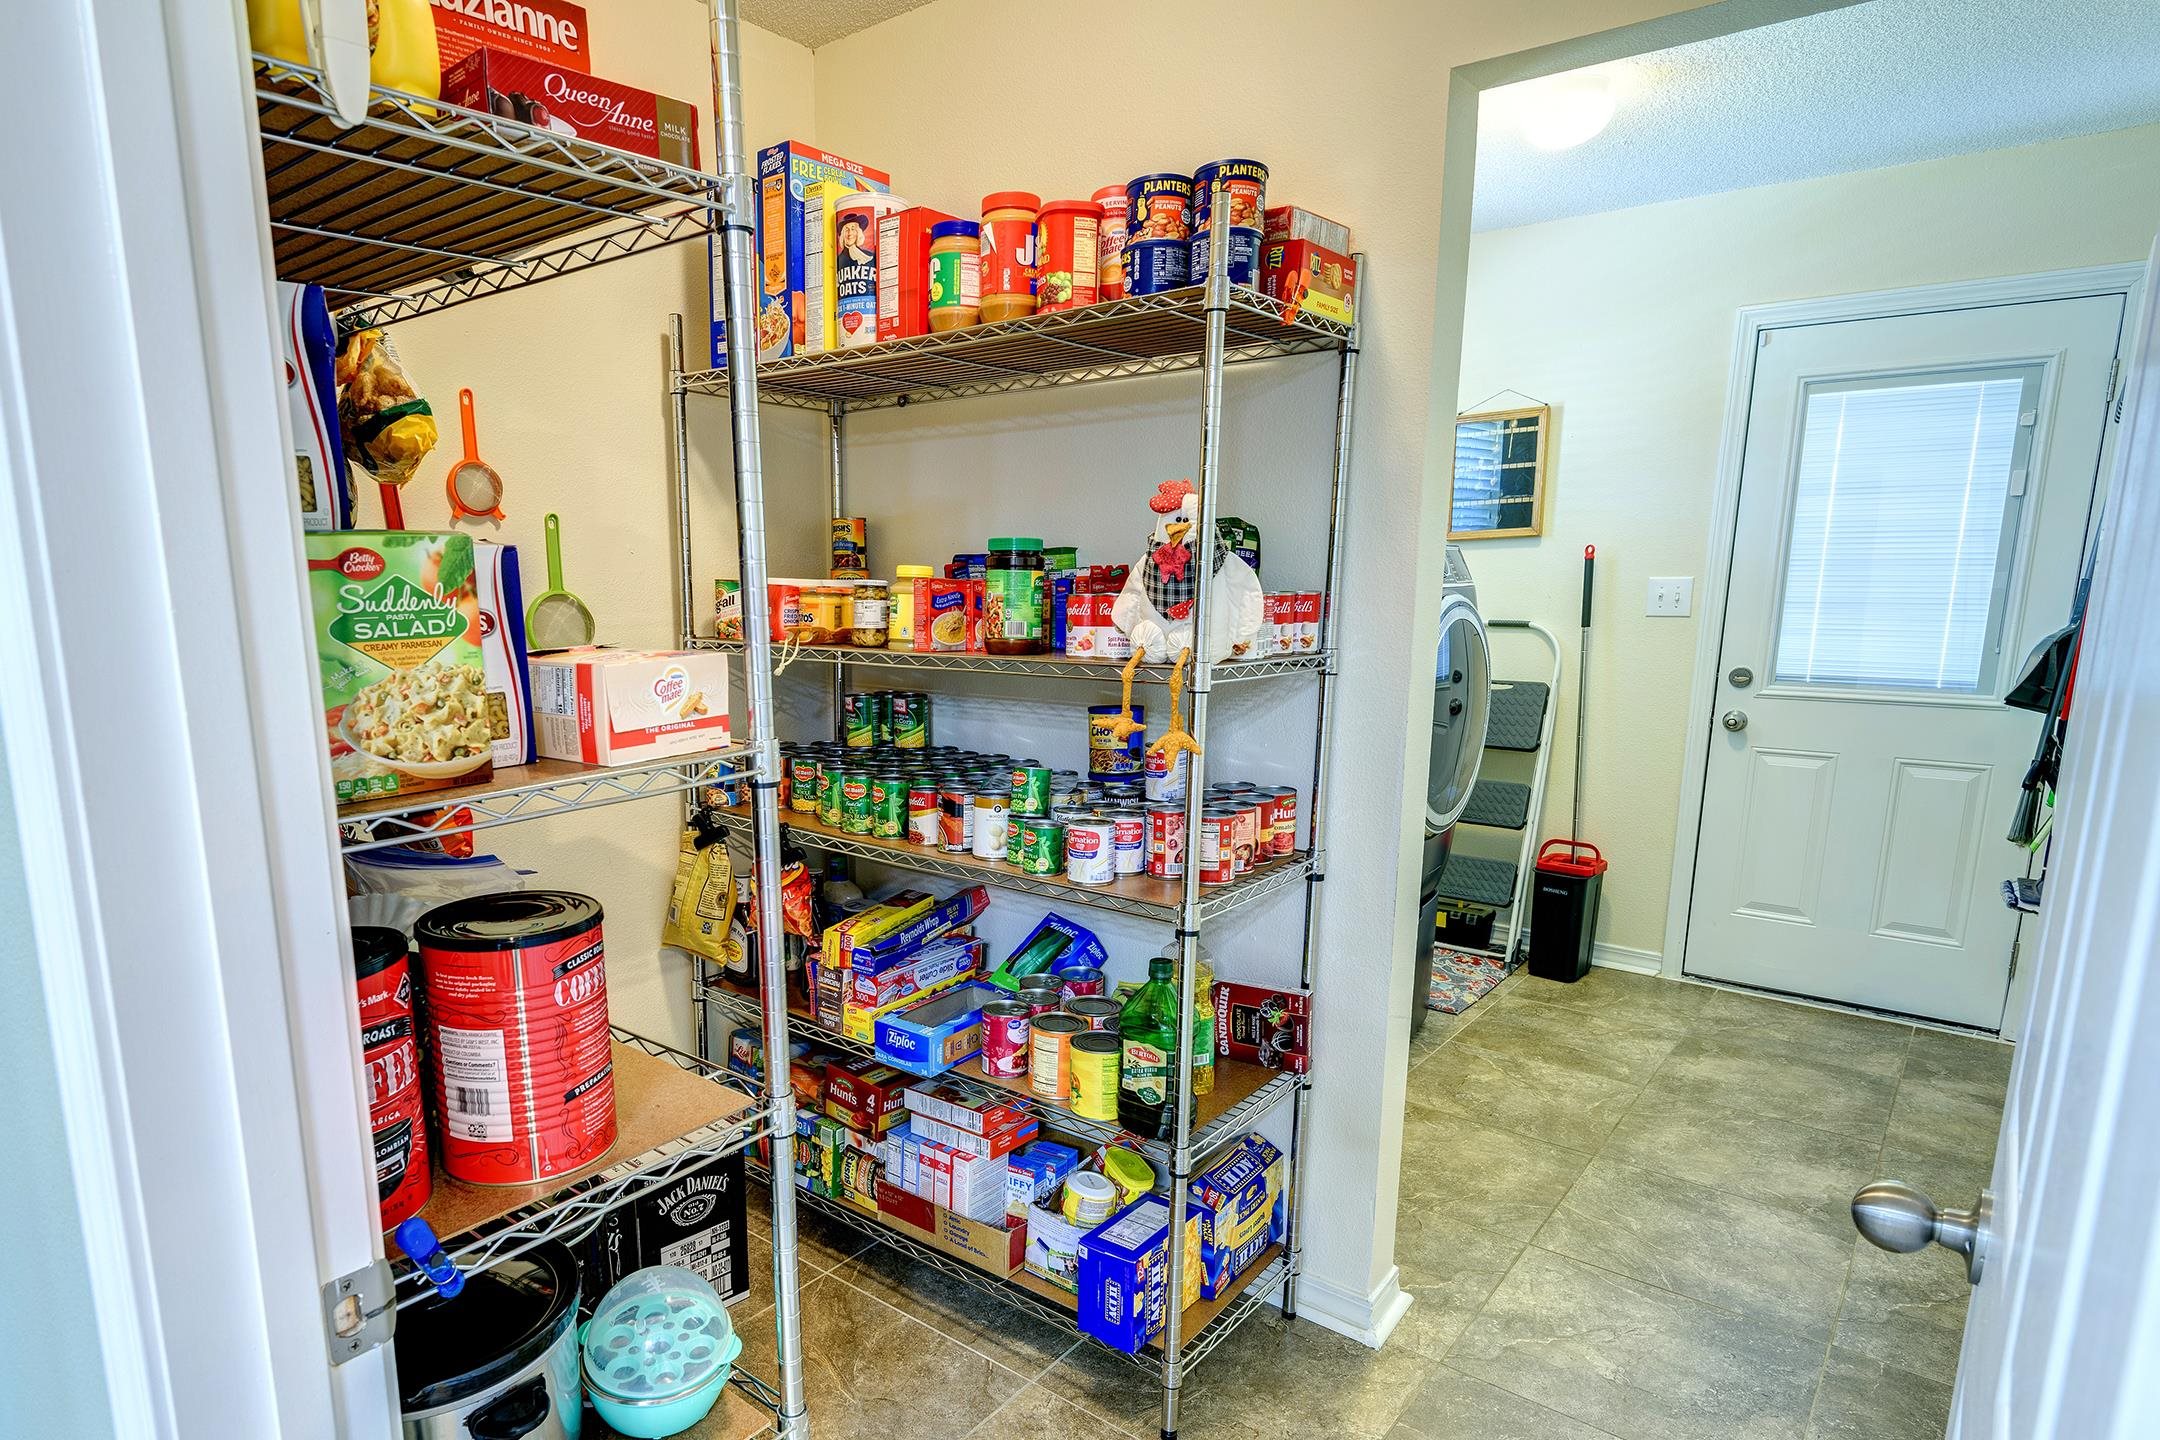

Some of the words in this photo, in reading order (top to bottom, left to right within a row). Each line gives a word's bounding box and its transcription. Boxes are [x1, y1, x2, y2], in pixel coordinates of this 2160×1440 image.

[430, 0, 579, 51] zianne
[458, 18, 486, 32] FAMILY
[487, 27, 512, 41] OWNED
[513, 36, 533, 47] SINCE
[544, 73, 611, 111] Queen
[606, 101, 655, 133] Anne
[627, 129, 641, 138] good
[660, 130, 691, 143] CHOCOLATE
[664, 122, 687, 135] MILK
[761, 151, 785, 168] FROSTED
[821, 153, 845, 169] MEGA
[846, 161, 864, 176] SIZE
[792, 159, 824, 181] FREE
[823, 167, 847, 179] CEREAL
[1218, 164, 1267, 182] PLANTERS
[1143, 179, 1192, 196] PLANTERS
[1230, 188, 1258, 197] PEANUTS
[1105, 200, 1128, 208] SERVIN
[1154, 204, 1183, 212] PEANUTS
[1100, 234, 1125, 249] offee
[1270, 245, 1285, 270] RITZ
[1310, 252, 1322, 272] RITZ
[837, 265, 877, 283] UAKER
[839, 281, 867, 297] OATS
[1315, 301, 1330, 311] FAMILY
[1330, 306, 1339, 314] SIZE
[349, 551, 376, 564] Betty
[1236, 549, 1256, 559] BEEF
[343, 560, 381, 573] Crocker
[336, 581, 458, 628] Suddenly
[715, 594, 735, 614] g-all
[1066, 603, 1091, 616] pbell's
[385, 613, 417, 621] PASTA
[353, 619, 446, 640] SALAD
[362, 642, 399, 652] CREAMY
[400, 639, 443, 650] PARMESAN
[654, 679, 684, 697] Coffee
[661, 688, 683, 704] mate
[645, 726, 660, 735] THE
[660, 721, 696, 732] ORIGINAL
[1091, 726, 1113, 737] CHO
[1273, 808, 1297, 819] Hun
[1542, 886, 1569, 896] BOSHENG
[900, 919, 926, 945] Reynolds
[923, 916, 940, 930] Wrap
[1049, 921, 1079, 939] Ziploc
[844, 936, 853, 951] 300
[1086, 940, 1104, 960] Ziploc
[566, 949, 594, 970] CLASSIC
[918, 969, 938, 982] Cutter
[938, 963, 954, 974] Slide
[367, 990, 388, 1006] Mark
[855, 991, 869, 1001] 300
[1217, 985, 1230, 1056] CANDIQUIK
[362, 1023, 397, 1045] ROAST
[888, 1029, 916, 1050] Ziploc
[445, 1058, 463, 1066] Questions
[1131, 1048, 1159, 1062] BERTOLLI
[364, 1038, 416, 1105] FEE
[829, 1082, 858, 1106] Hunt's
[866, 1094, 876, 1108] 4
[883, 1097, 904, 1113] Hun
[371, 1110, 401, 1127] ABICA
[375, 1133, 409, 1158] LOMBIAN
[844, 1152, 856, 1186] BUSH'S
[1235, 1156, 1253, 1179] ACT
[1009, 1177, 1032, 1191] IFFY
[656, 1184, 687, 1216] JACK
[686, 1172, 730, 1195] DANIEL'S
[687, 1200, 699, 1208] Old
[1206, 1219, 1214, 1246] PANTRY
[1248, 1234, 1266, 1258] ACT
[1151, 1261, 1161, 1287] II
[1109, 1297, 1118, 1320] ACT
[1151, 1286, 1161, 1322] ACT
